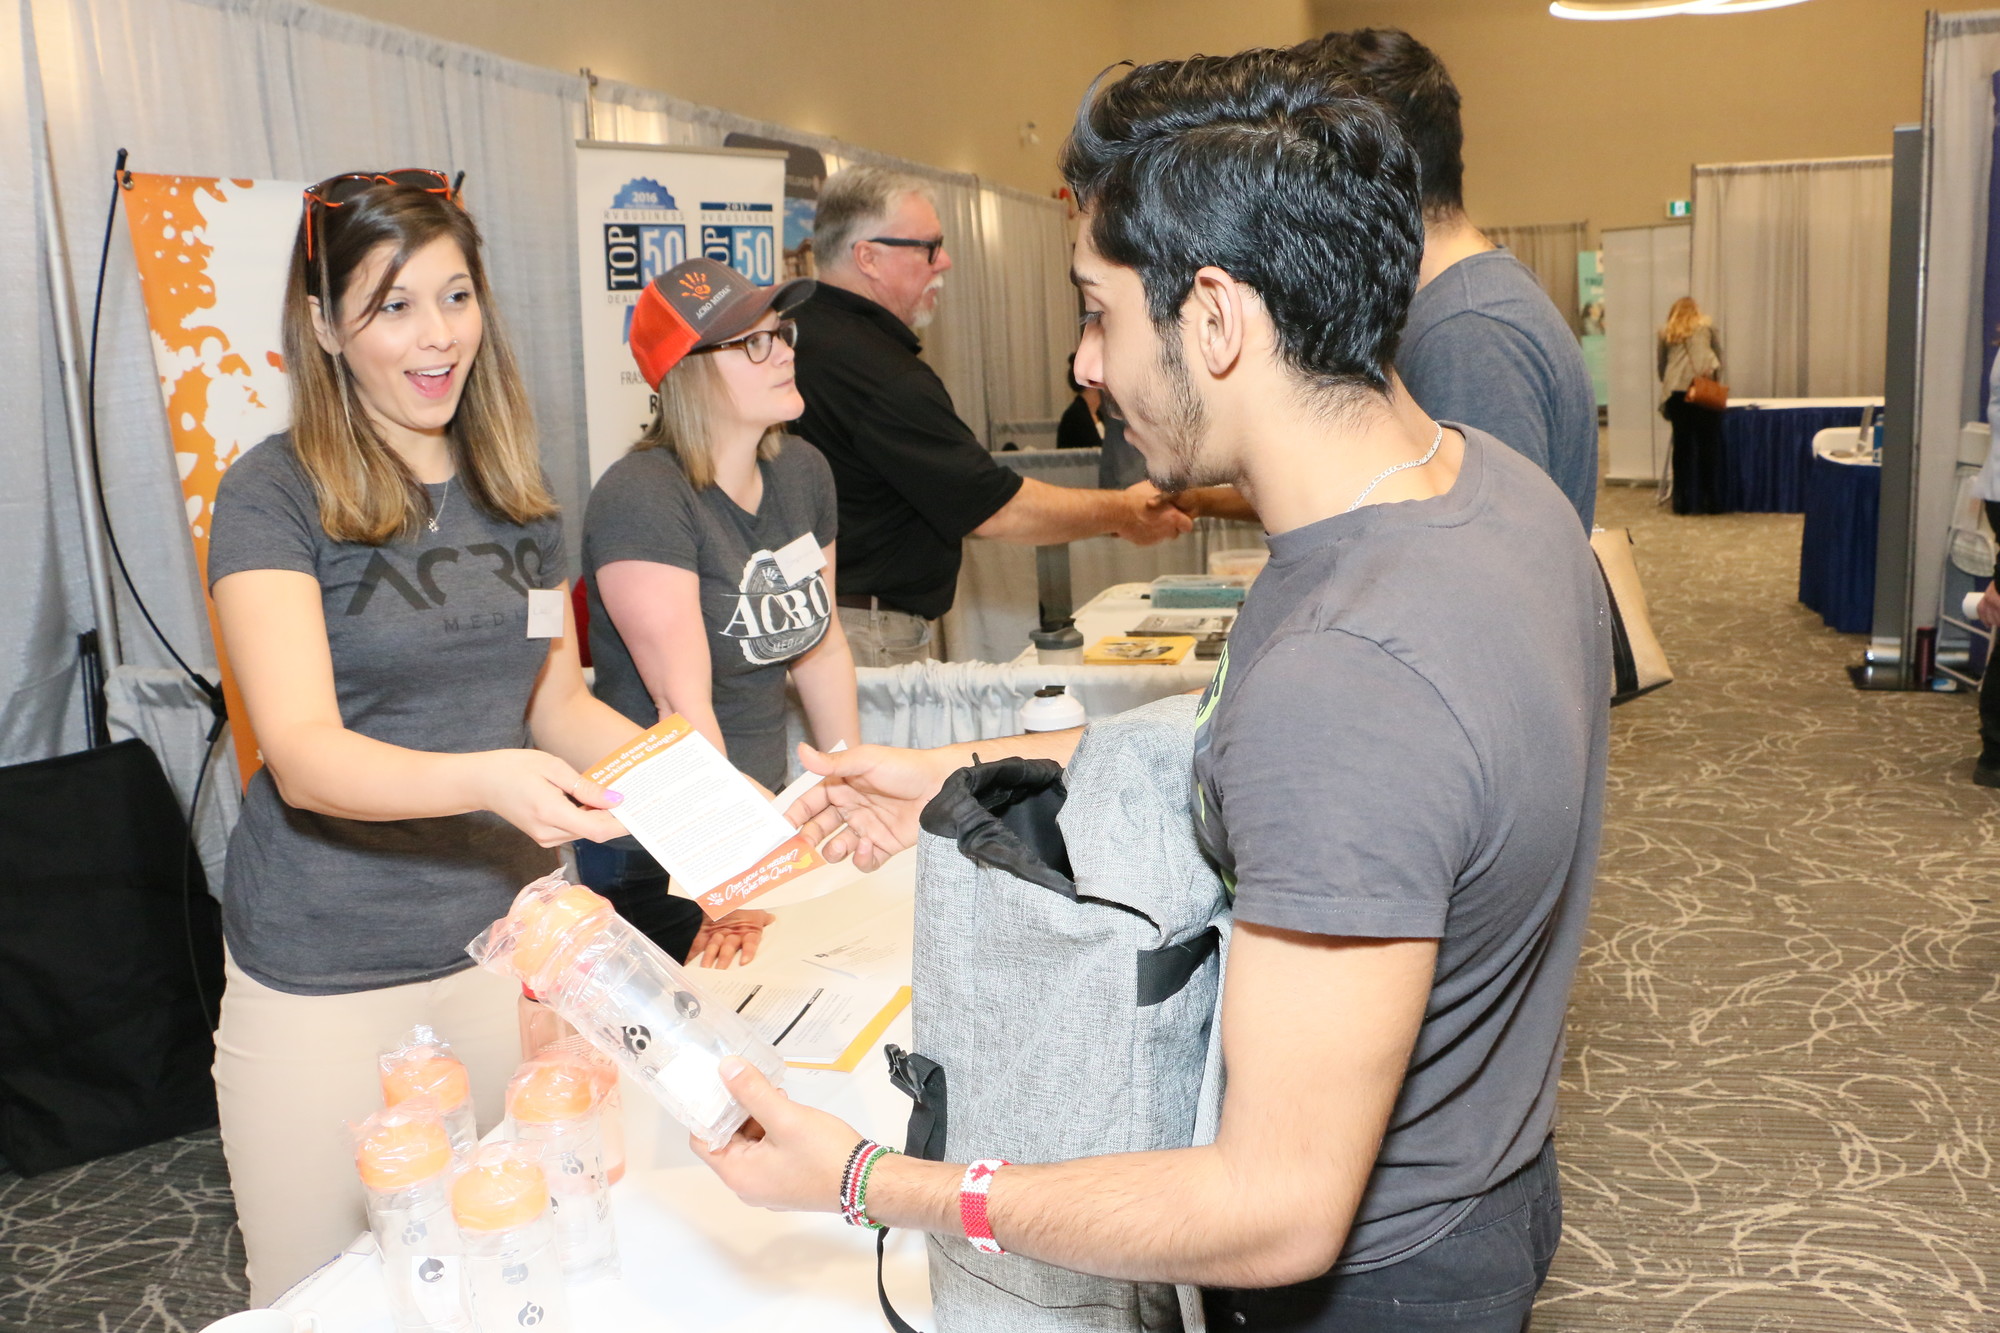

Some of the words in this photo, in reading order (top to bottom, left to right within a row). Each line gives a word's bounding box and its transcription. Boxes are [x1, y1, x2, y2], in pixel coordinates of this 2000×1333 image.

[607, 225, 639, 289] TOP
[642, 229, 684, 283] 50
[735, 231, 772, 281] 50
[695, 302, 713, 320] ACRO
[710, 287, 731, 306] MEDIA
[620, 370, 646, 385] FRAS
[718, 576, 831, 638] ACRO
[591, 769, 606, 780] Do
[604, 758, 621, 772] you
[620, 741, 648, 760] dream
[647, 734, 658, 743] of
[631, 751, 646, 761] for
[644, 729, 680, 753] Google?
[725, 880, 743, 900] Are
[742, 869, 759, 884] you
[759, 866, 766, 874] a
[735, 880, 759, 899] Take
[758, 874, 770, 886] the
